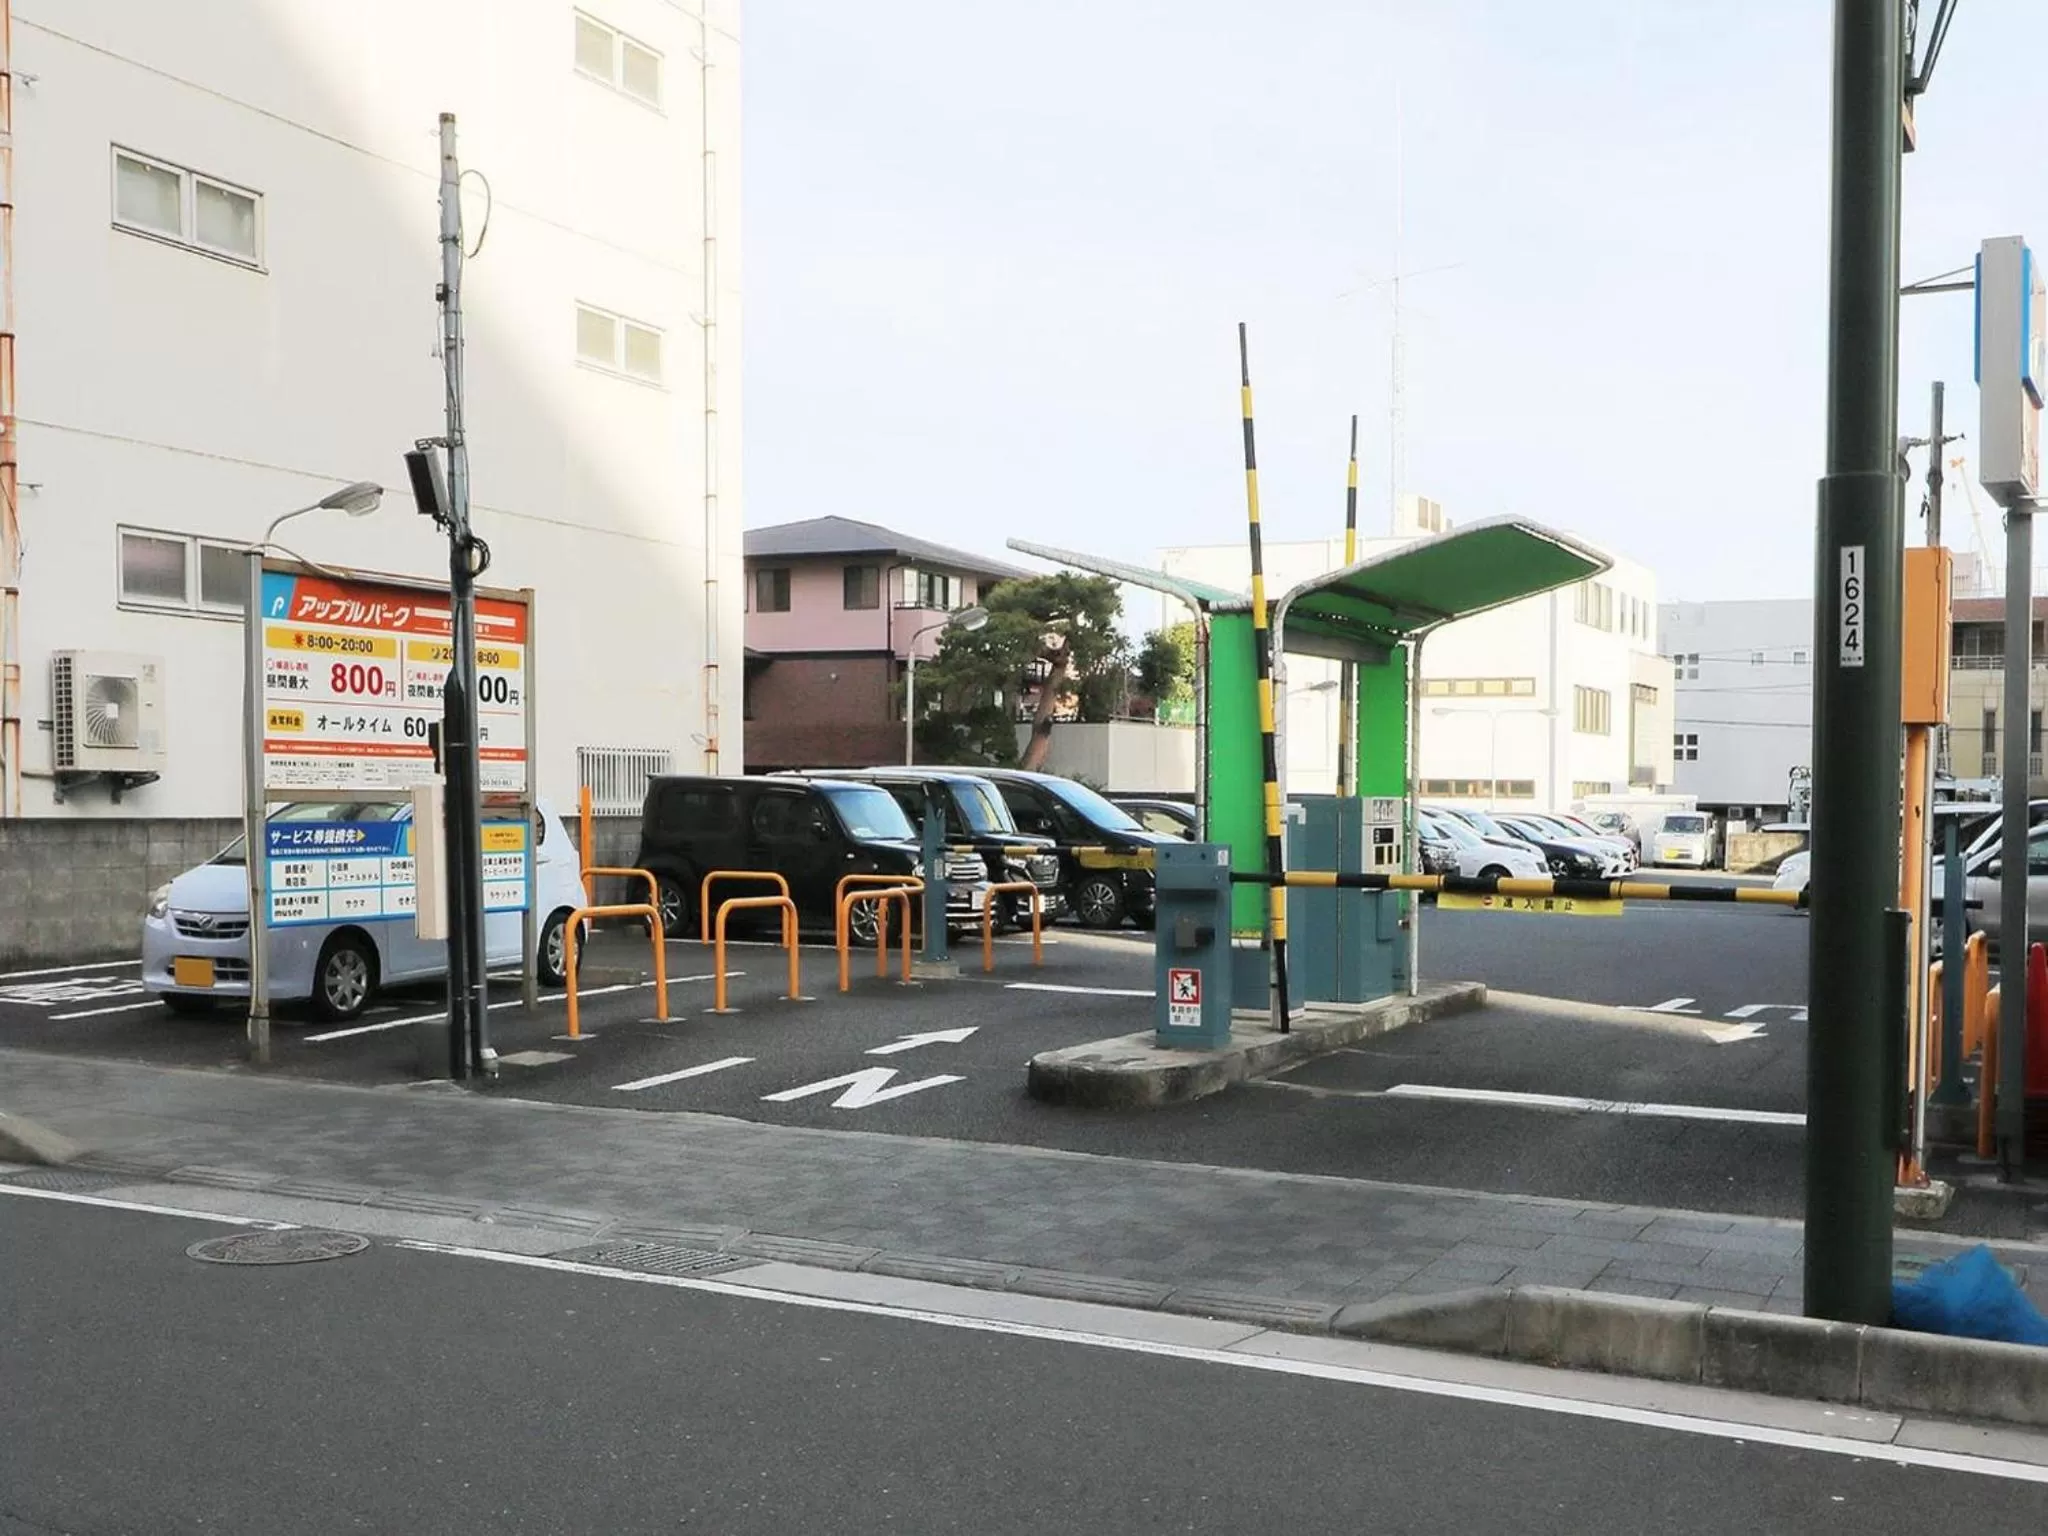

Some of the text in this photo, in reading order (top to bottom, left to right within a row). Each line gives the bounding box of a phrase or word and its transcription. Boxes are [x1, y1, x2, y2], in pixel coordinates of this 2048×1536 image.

[298, 595, 410, 627] アップルパーク
[1845, 551, 1860, 651] 1624
[267, 674, 309, 690] 昼間最大
[317, 715, 392, 733] オールタイム
